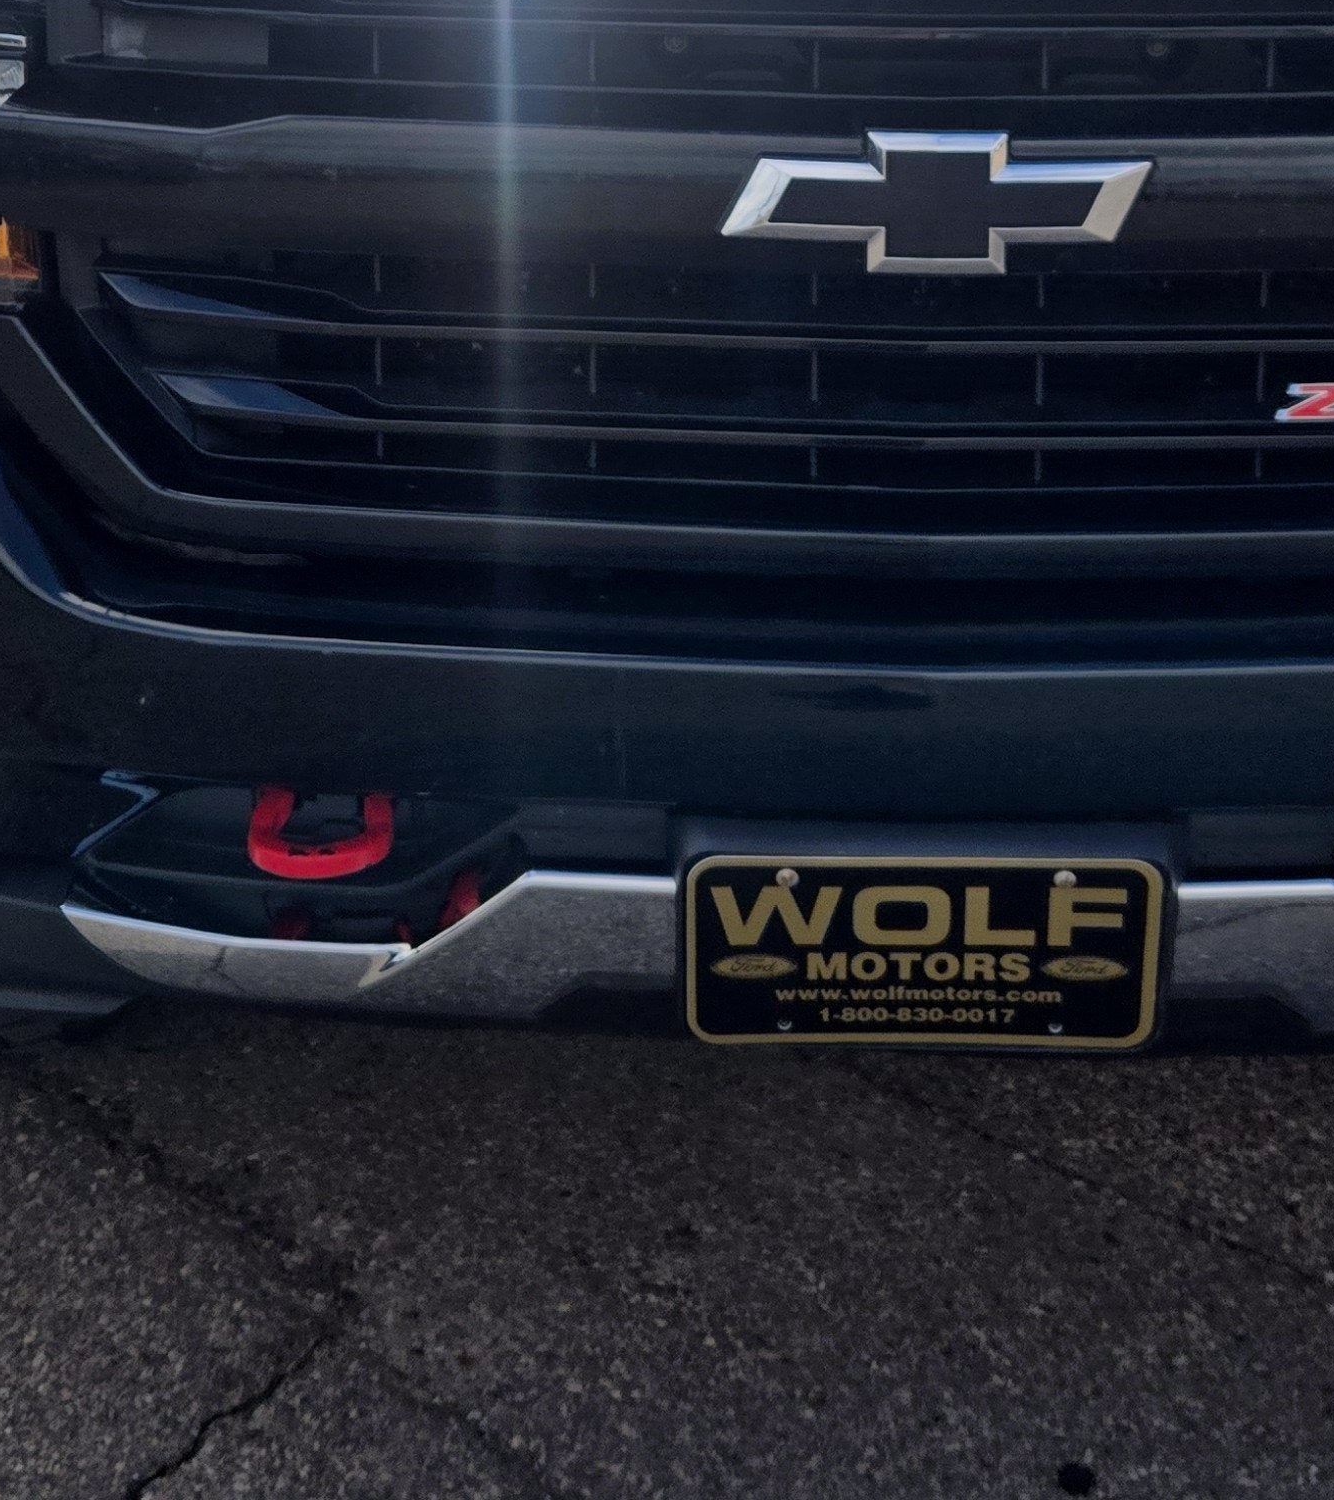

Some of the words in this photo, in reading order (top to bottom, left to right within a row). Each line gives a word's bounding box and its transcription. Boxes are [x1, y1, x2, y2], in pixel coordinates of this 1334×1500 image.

[710, 885, 1129, 947] WOLF
[806, 952, 1031, 982] MOTORS
[775, 985, 1063, 1003] www.wolfmotors.com
